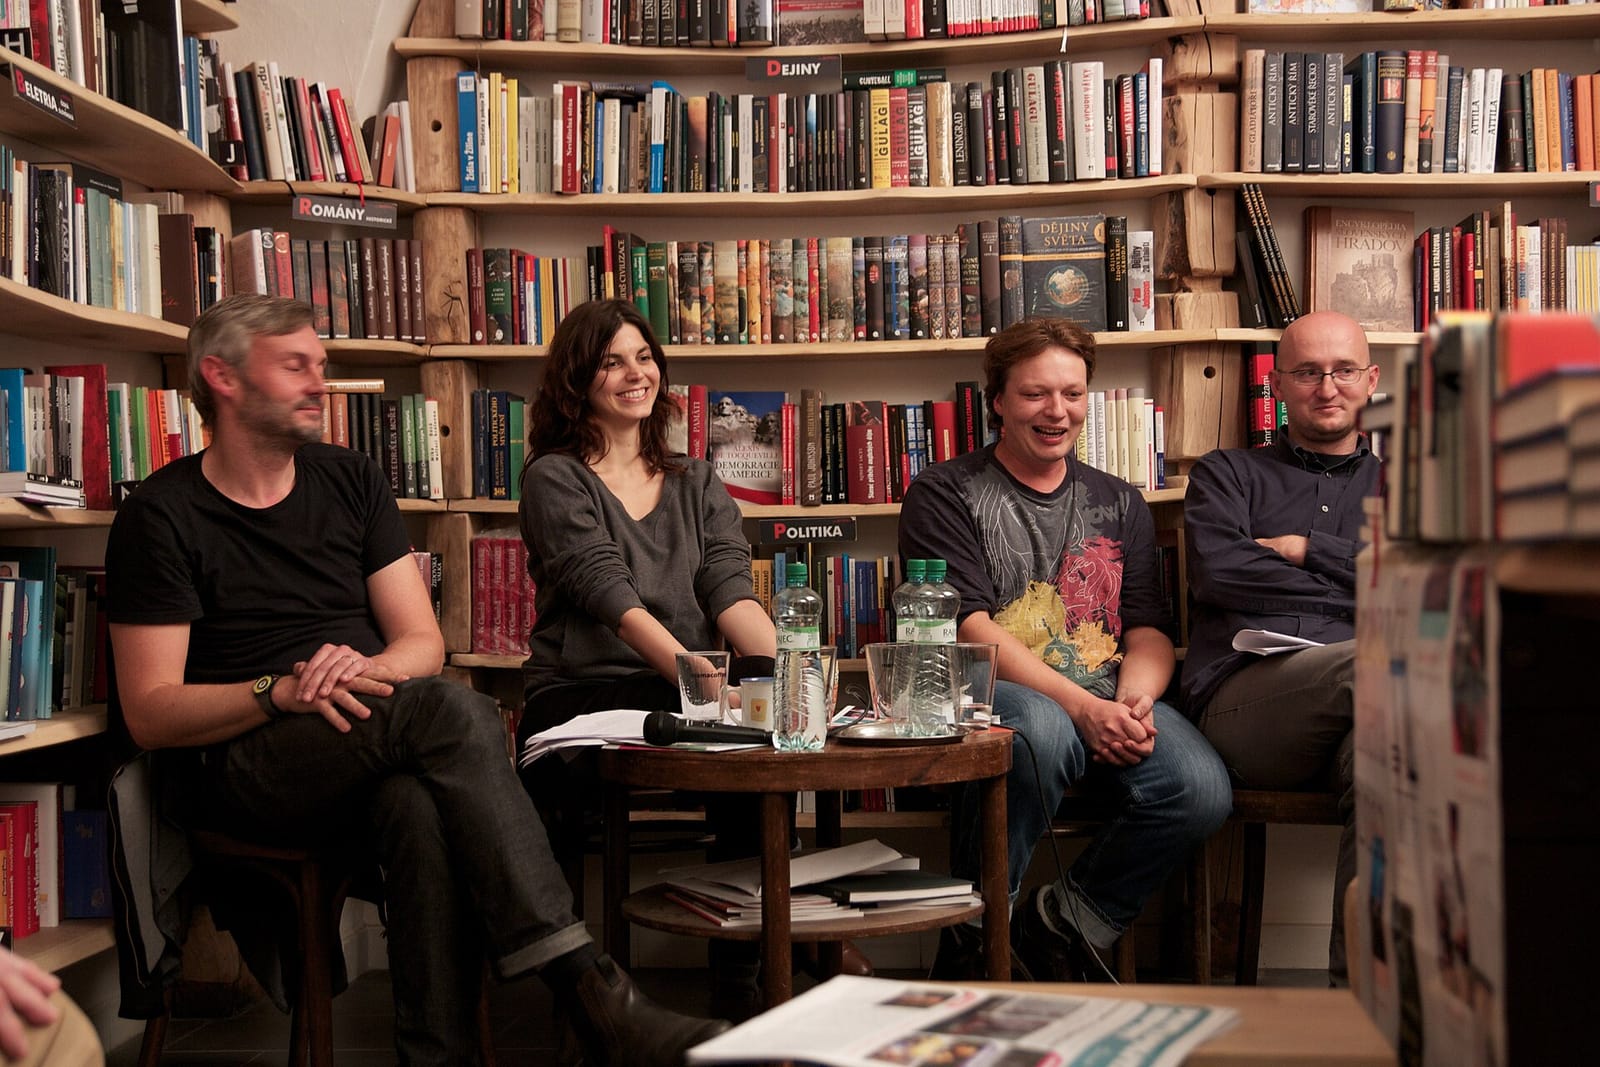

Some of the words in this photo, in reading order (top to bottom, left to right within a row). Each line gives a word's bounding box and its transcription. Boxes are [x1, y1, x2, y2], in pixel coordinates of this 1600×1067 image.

[4, 32, 25, 56] H
[766, 59, 822, 77] DEJINY
[1267, 63, 1278, 82] ŘÍM
[1287, 62, 1298, 81] ŘÍM
[1326, 63, 1337, 82] ŘÍM
[15, 68, 59, 113] BELETRIA
[1027, 72, 1038, 123] GULAGU
[1267, 84, 1277, 126] ANTICKÝ
[1287, 83, 1298, 125] ANTICKÝ
[1326, 84, 1337, 126] ANTICKÝ
[913, 104, 924, 155] GULAG
[1248, 91, 1257, 144] GLADIÁTOŘI
[1471, 100, 1480, 136] ATTILA
[1487, 99, 1498, 136] ATTILA
[878, 107, 888, 156] GULAG
[895, 106, 906, 155] GULAG
[953, 111, 965, 162] LENINGRAD
[226, 142, 236, 163] J
[298, 197, 365, 222] ROMÁNY
[1040, 221, 1089, 236] DĚJINY
[1044, 233, 1086, 247] SVĚTA
[1335, 237, 1407, 252] HRADOV
[617, 239, 626, 283] CIVILIZACE
[1131, 246, 1142, 269] Dějiny
[1132, 287, 1141, 303] Paul
[1261, 375, 1272, 412] mrežami
[387, 406, 397, 431] MOŘE
[1264, 413, 1272, 424] za
[1281, 415, 1289, 426] za
[388, 432, 399, 489] KATEDRÁLA
[715, 461, 779, 469] DEMOKRACIE
[728, 452, 778, 460] TOCQUEVILLE
[807, 442, 816, 472] JOHNSON
[730, 470, 773, 479] AMERICE
[807, 473, 816, 488] PAUL
[774, 522, 843, 540] POLITIKA
